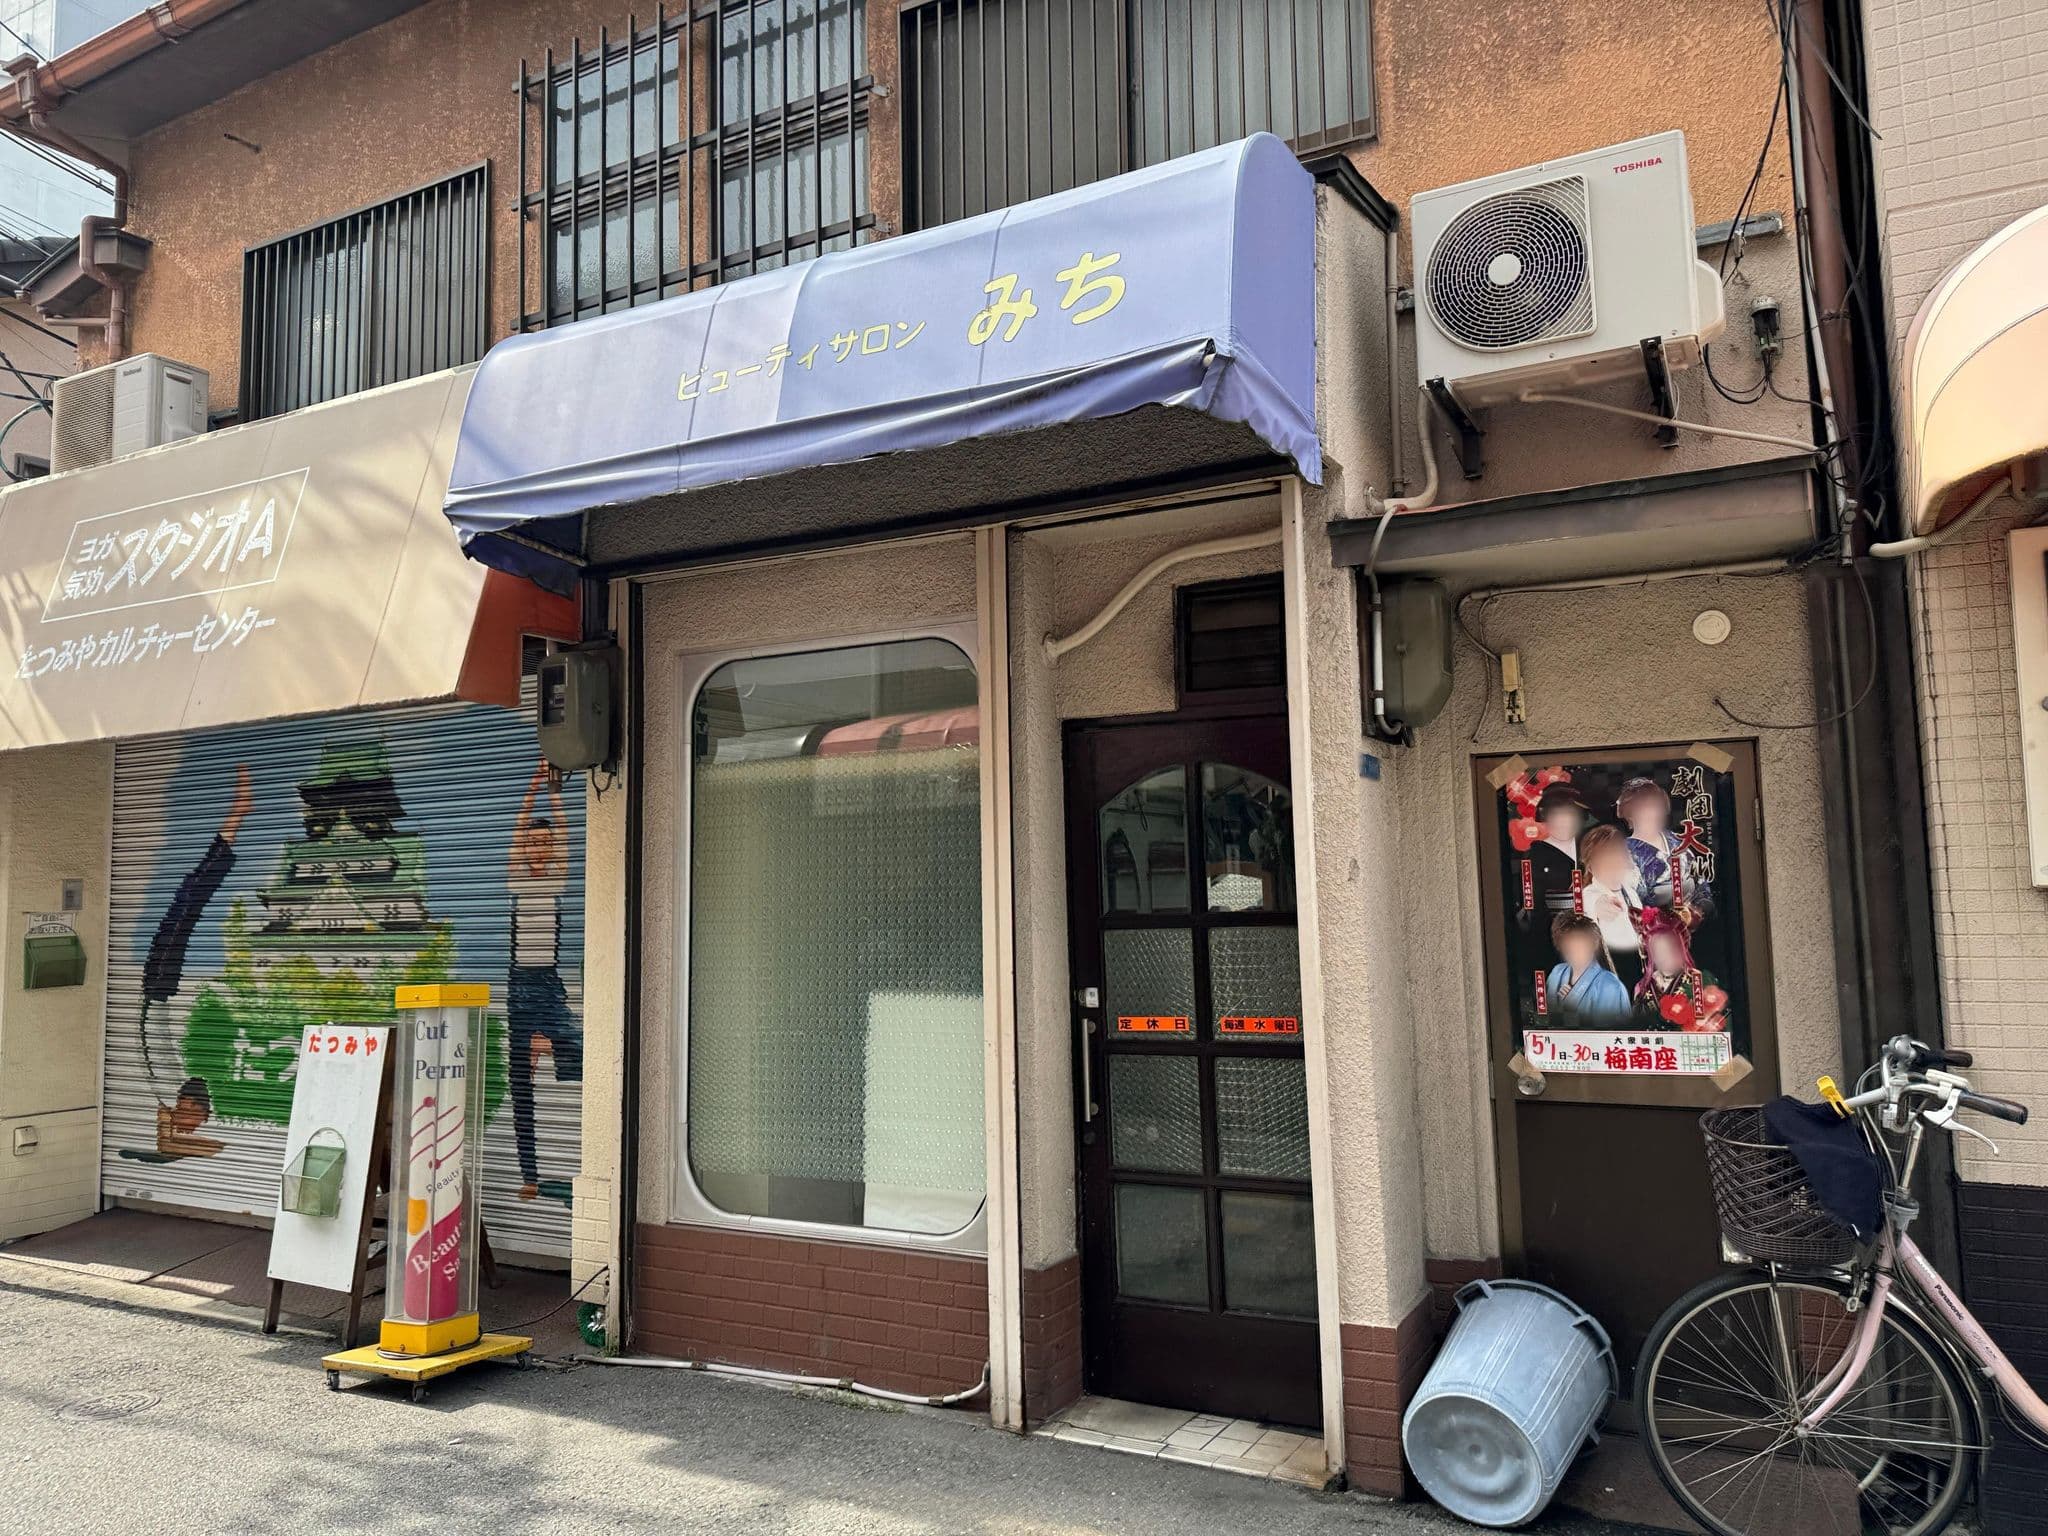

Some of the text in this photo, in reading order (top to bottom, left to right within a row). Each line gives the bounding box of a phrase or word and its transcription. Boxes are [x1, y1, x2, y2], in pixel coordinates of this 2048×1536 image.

[1613, 157, 1663, 174] TOSHIBA
[677, 252, 1128, 401] ビューティサロン みち
[77, 530, 120, 564] ヨガ
[104, 498, 276, 594] スタジオA
[62, 566, 105, 601] 気功
[14, 606, 277, 680] たつみやカルチャーセンター
[415, 1019, 449, 1041] Cut
[1119, 1018, 1188, 1031] 定休日
[1224, 1019, 1296, 1032] 毎週水曜日
[308, 1033, 378, 1057] たつみや
[454, 1042, 465, 1058] &
[414, 1059, 466, 1080] Perm
[1604, 1045, 1678, 1071] 梅南座
[1934, 1284, 1964, 1321] Panasonic
